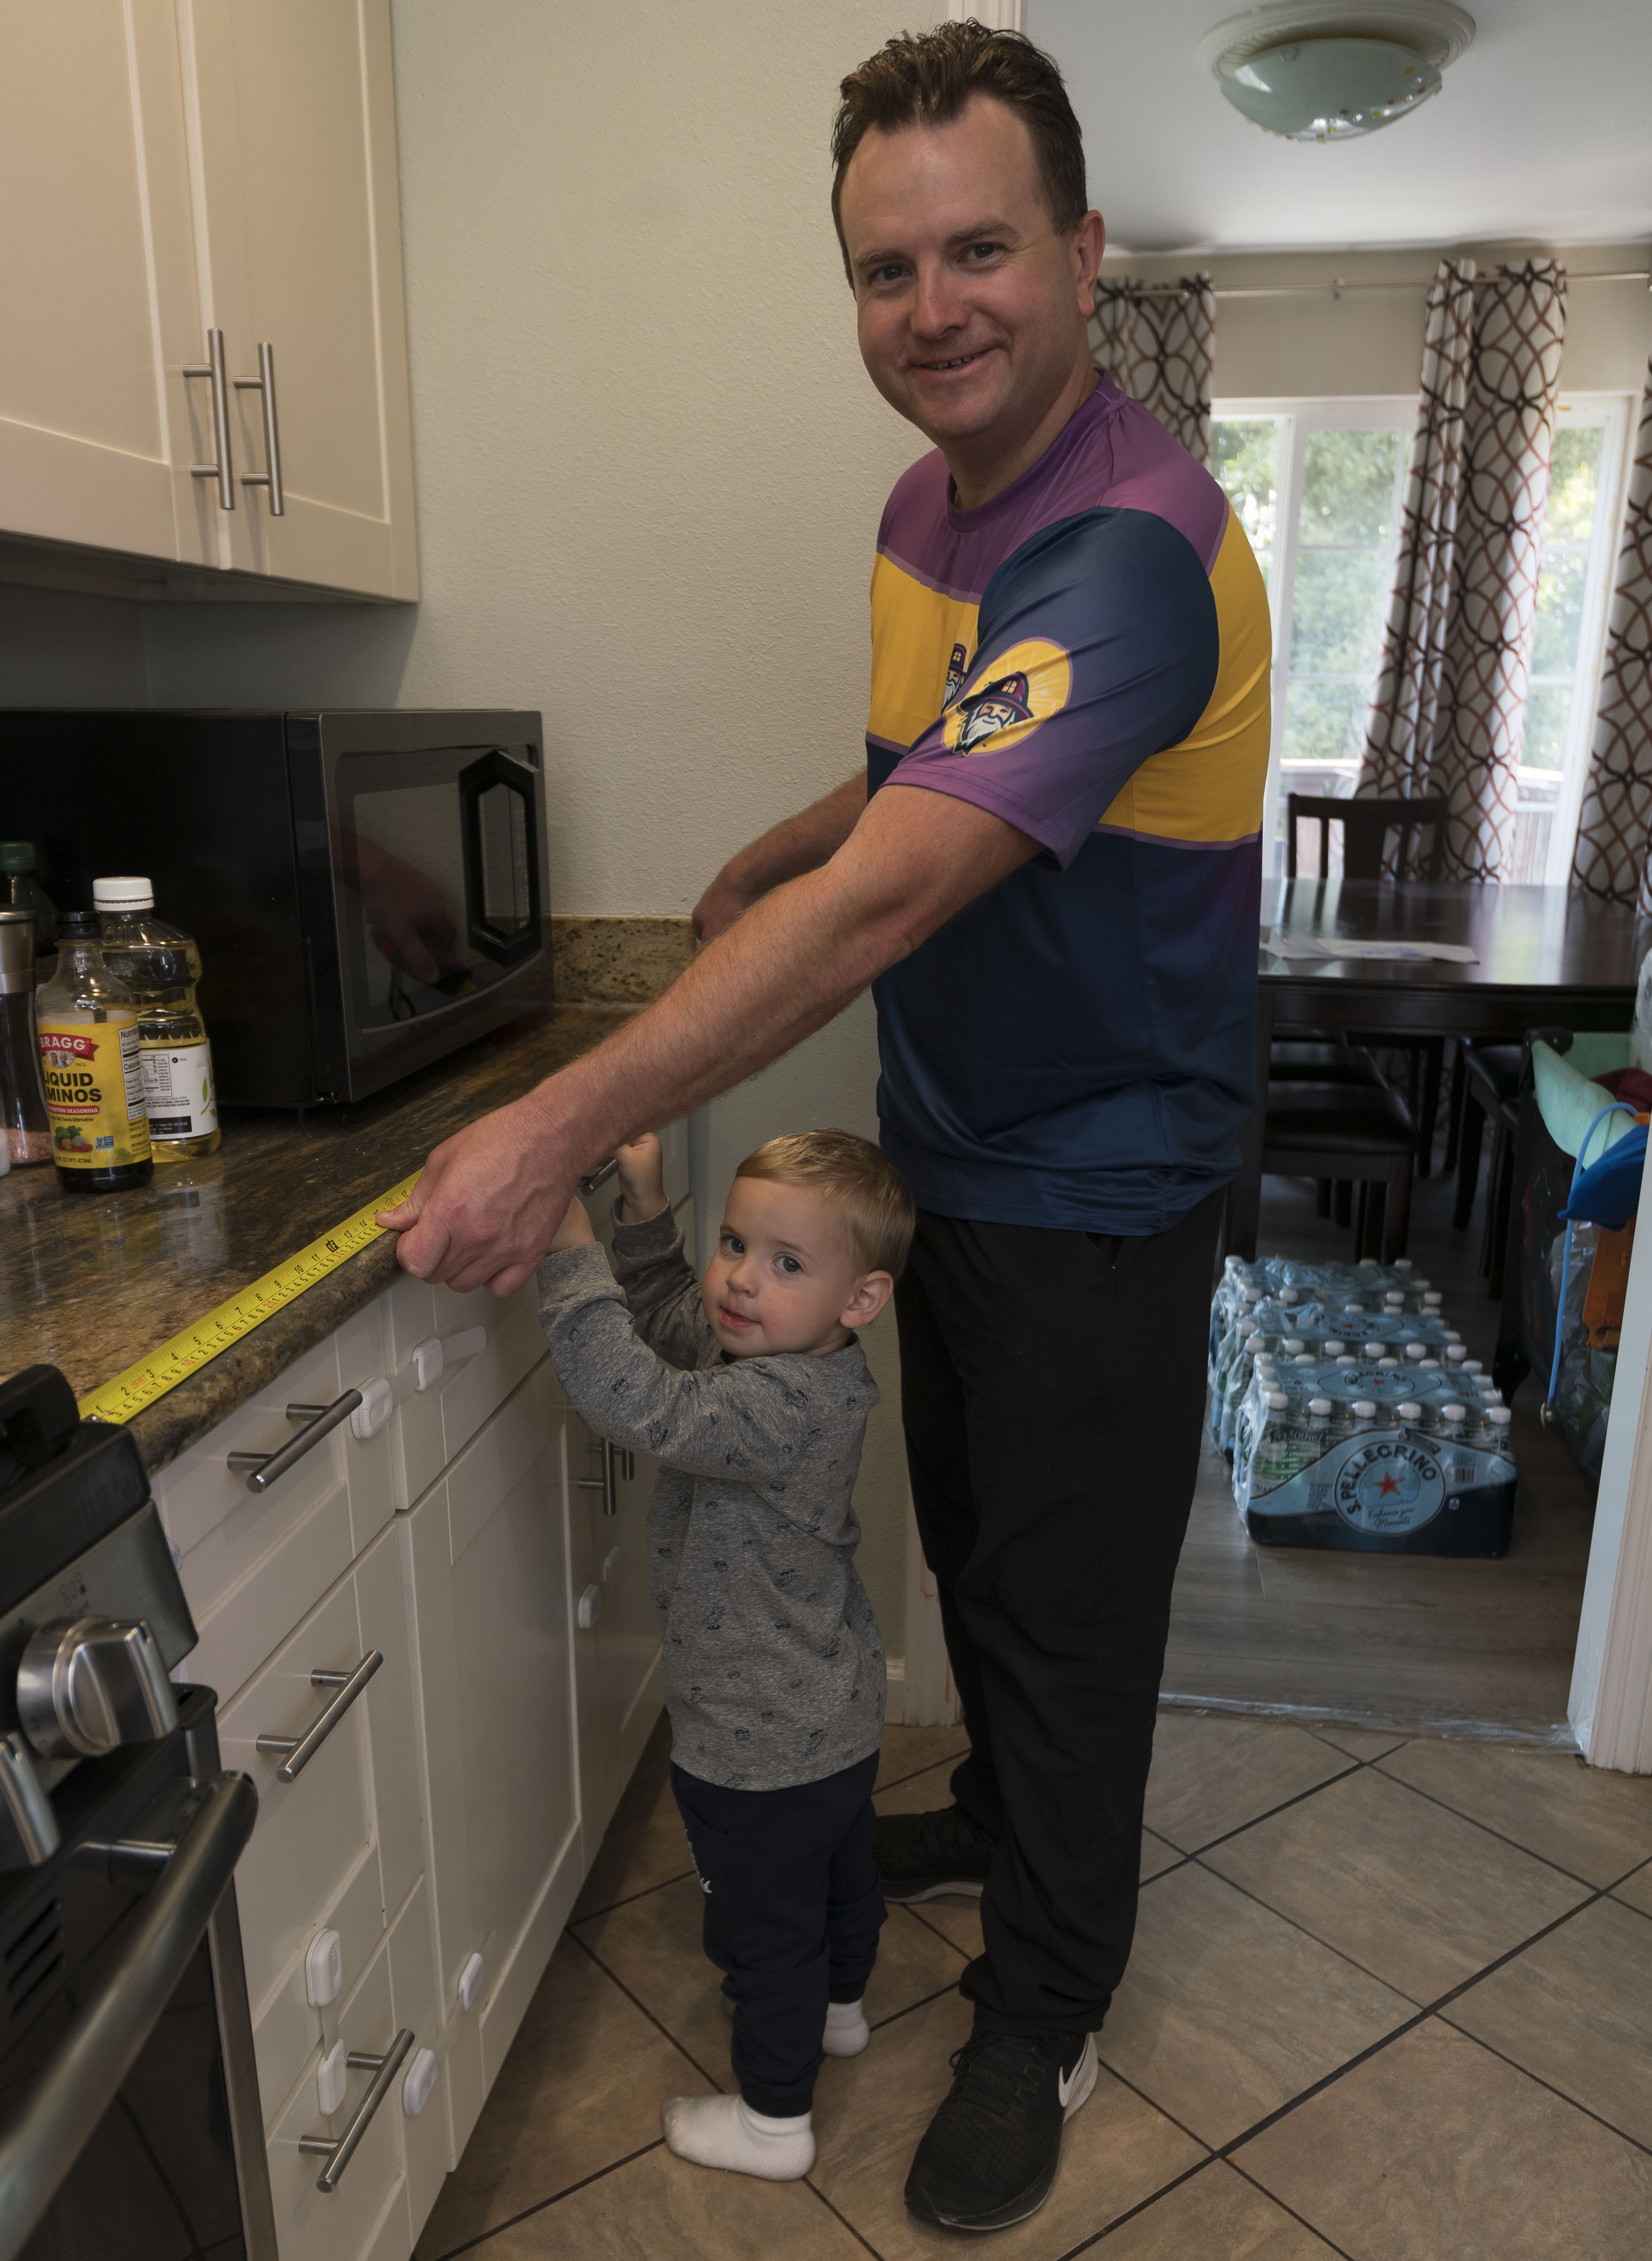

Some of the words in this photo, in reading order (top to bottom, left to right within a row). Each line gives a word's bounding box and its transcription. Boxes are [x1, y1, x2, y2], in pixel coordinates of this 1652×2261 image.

[40, 1036, 85, 1051] BRAGG
[121, 1387, 130, 1396] 2
[146, 1369, 154, 1378] 3
[171, 1352, 179, 1360] 4
[193, 1336, 201, 1345] 5
[215, 1321, 223, 1330] 6
[235, 1307, 243, 1315] 7
[274, 1280, 282, 1288] 9
[294, 1264, 303, 1274] 10
[311, 1253, 321, 1263] 11
[344, 1230, 353, 1239] 13
[359, 1220, 368, 1228] 14
[387, 1200, 396, 1208] 16
[401, 1190, 409, 1198] 17
[1367, 1507, 1399, 1519] Enhance
[1400, 1507, 1415, 1516] your
[1374, 1517, 1411, 1529] Moments
